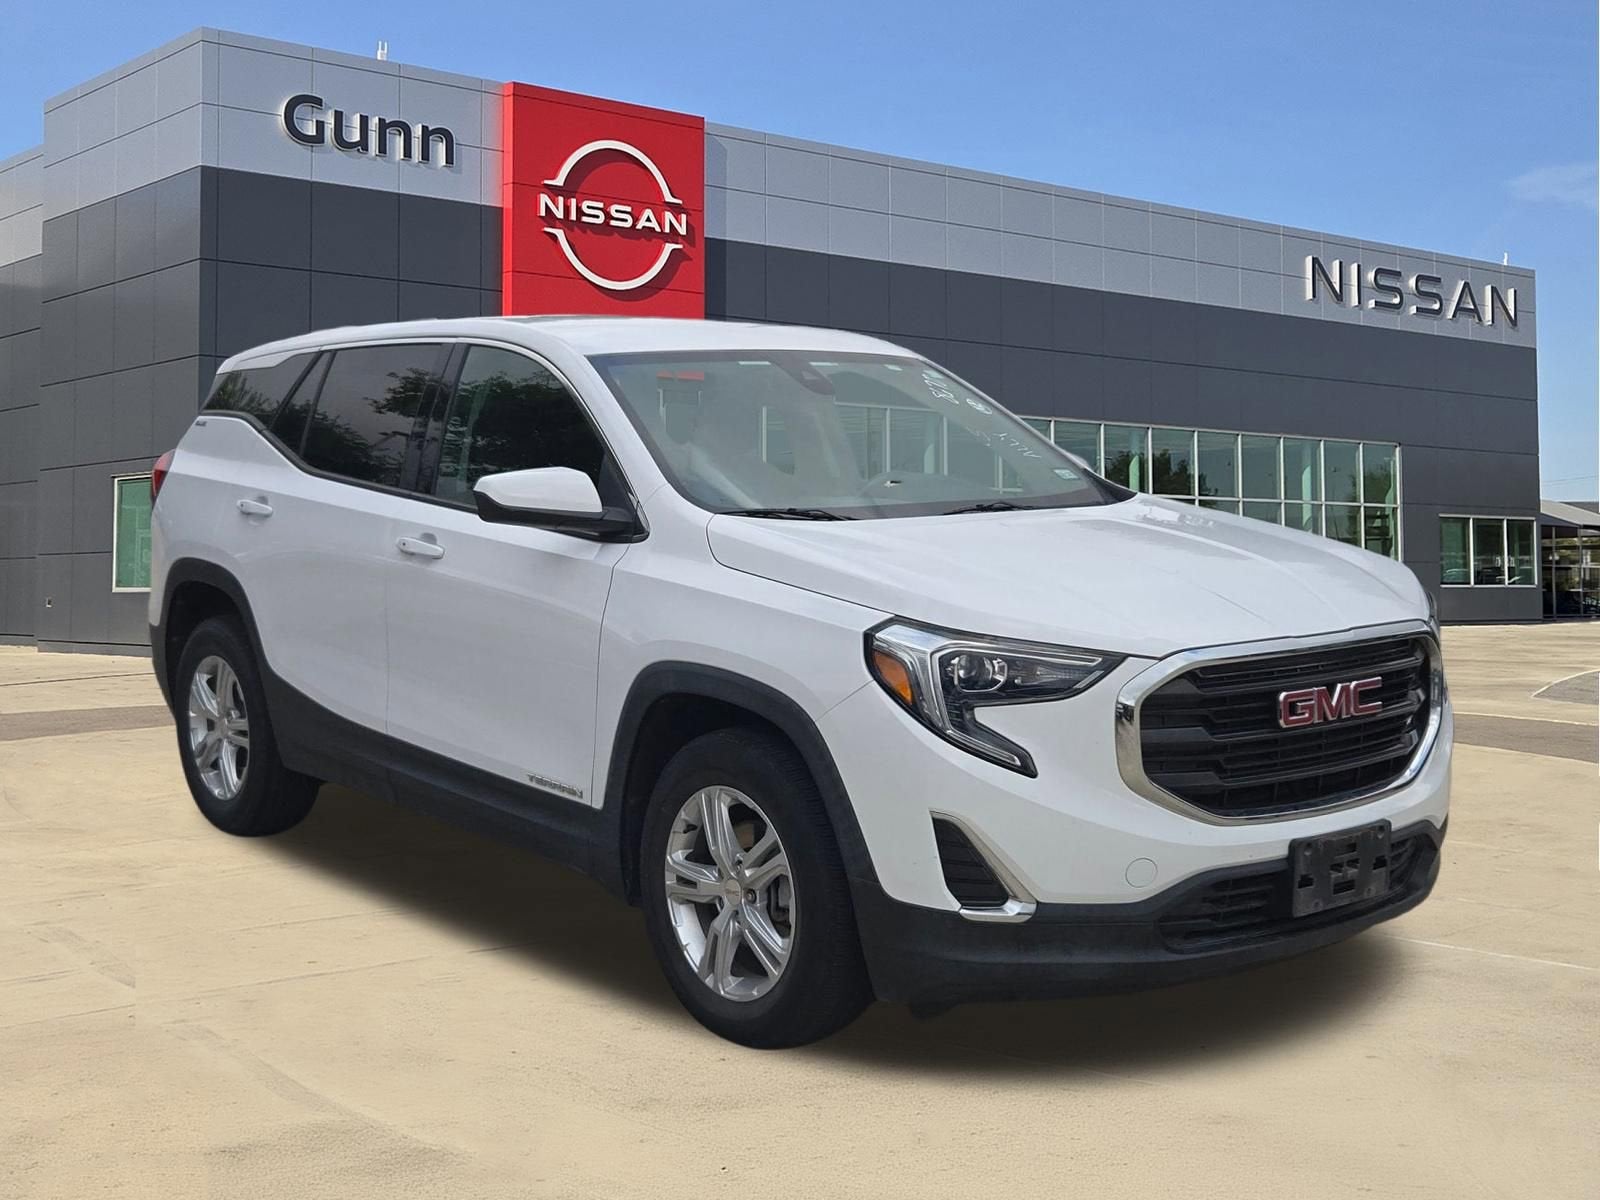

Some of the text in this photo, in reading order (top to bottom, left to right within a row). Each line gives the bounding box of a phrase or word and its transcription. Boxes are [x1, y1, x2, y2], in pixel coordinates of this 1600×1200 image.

[282, 94, 455, 167] Gunn
[537, 193, 688, 236] NISSAN
[1305, 255, 1518, 327] NISSAN
[1279, 676, 1382, 728] GMC
